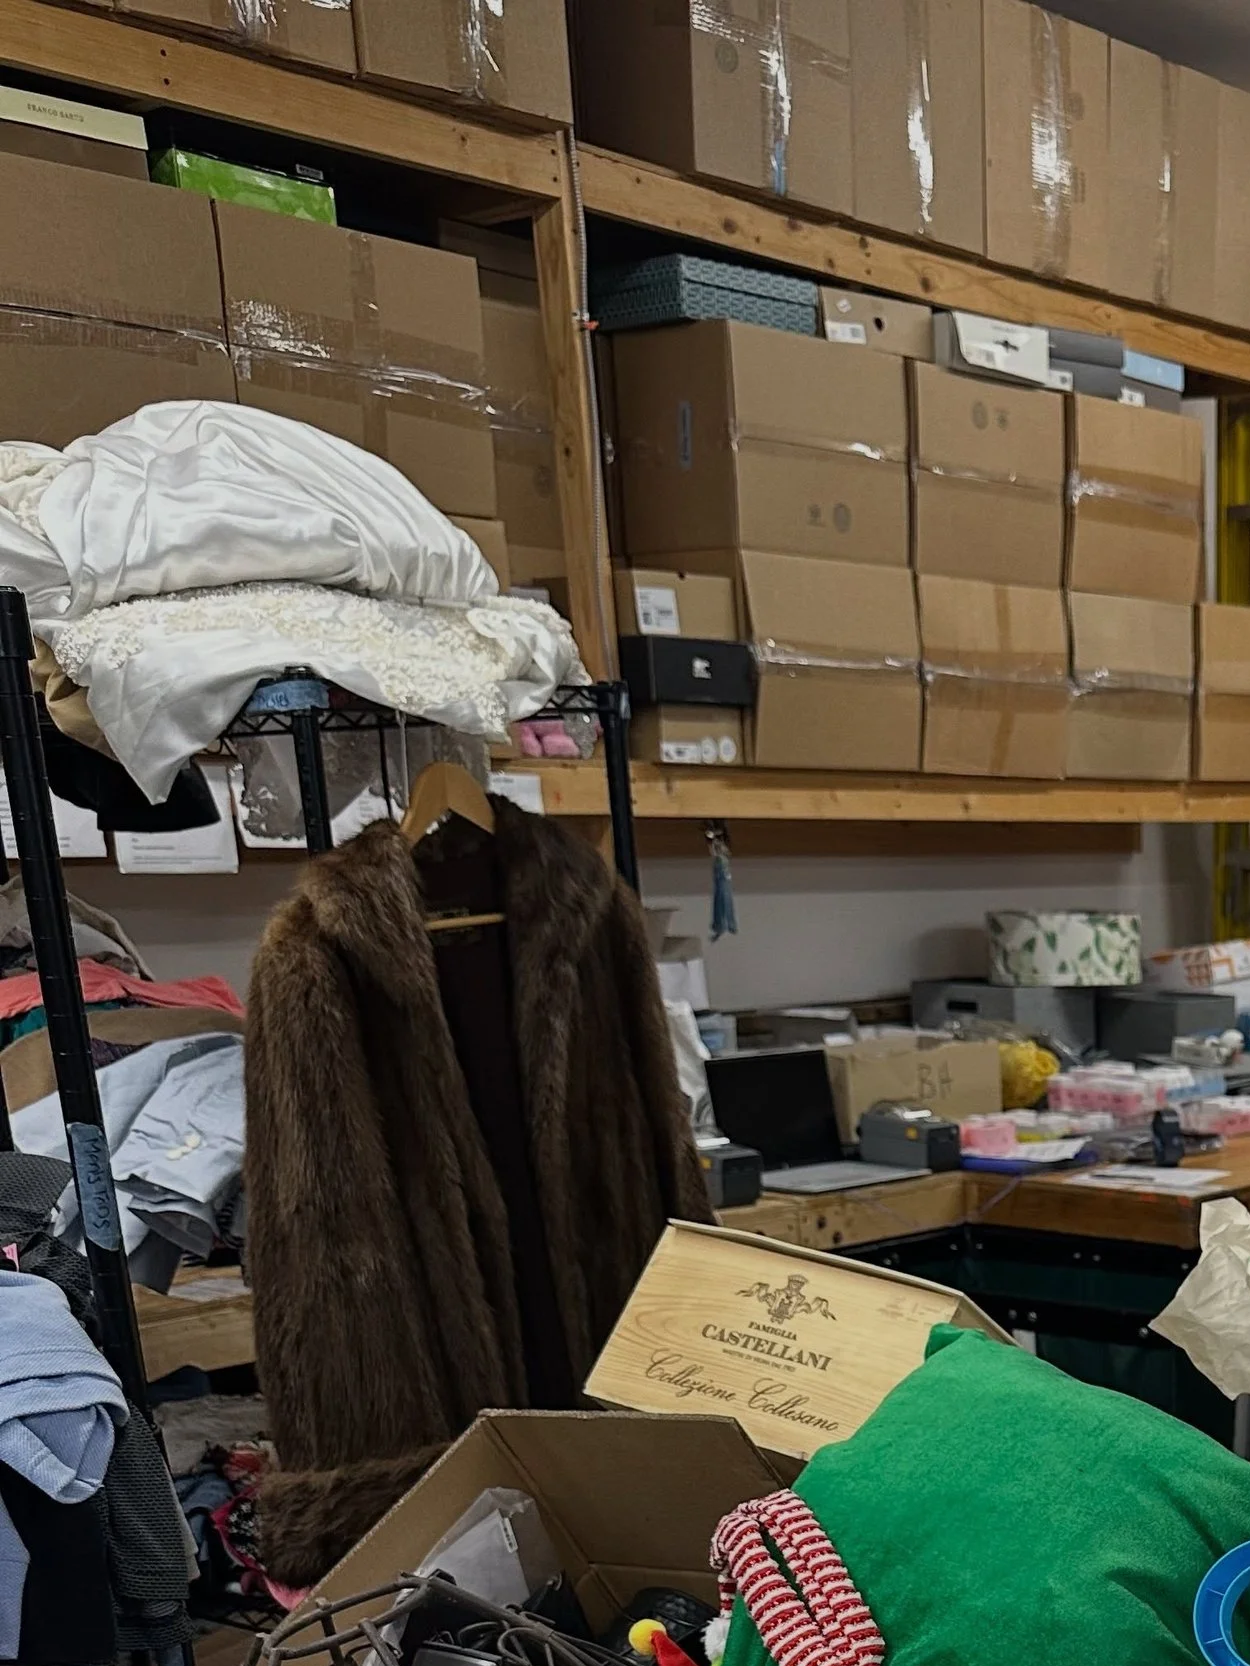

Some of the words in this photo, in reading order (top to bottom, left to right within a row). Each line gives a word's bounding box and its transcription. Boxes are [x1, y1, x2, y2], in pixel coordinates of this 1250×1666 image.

[702, 1323, 832, 1371] CASTELLANI
[748, 1321, 797, 1341] FAMIGLIA
[645, 1348, 737, 1403] Collezione
[748, 1378, 839, 1432] Collesano
